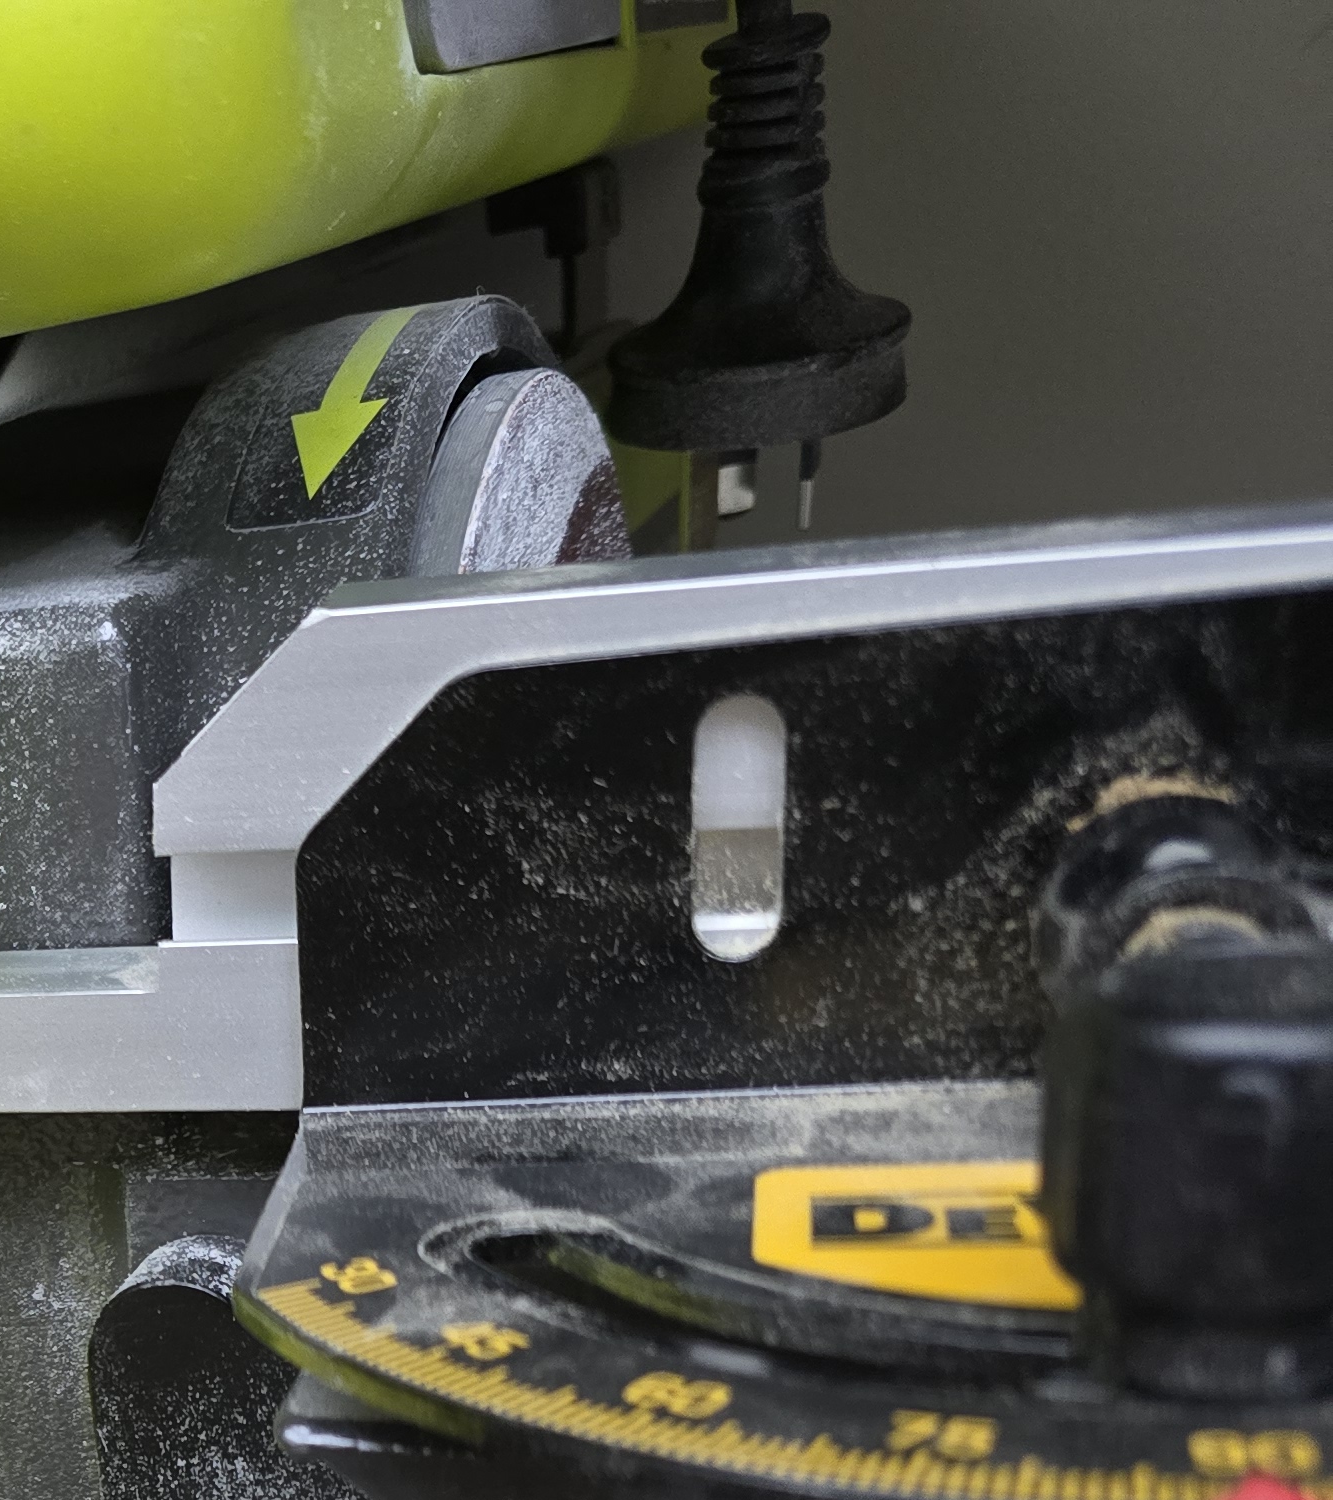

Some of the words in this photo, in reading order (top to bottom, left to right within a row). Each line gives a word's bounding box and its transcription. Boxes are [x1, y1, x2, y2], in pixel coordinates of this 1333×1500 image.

[810, 1195, 1025, 1250] DE
[621, 1370, 733, 1421] 60
[885, 1408, 999, 1462] 75
